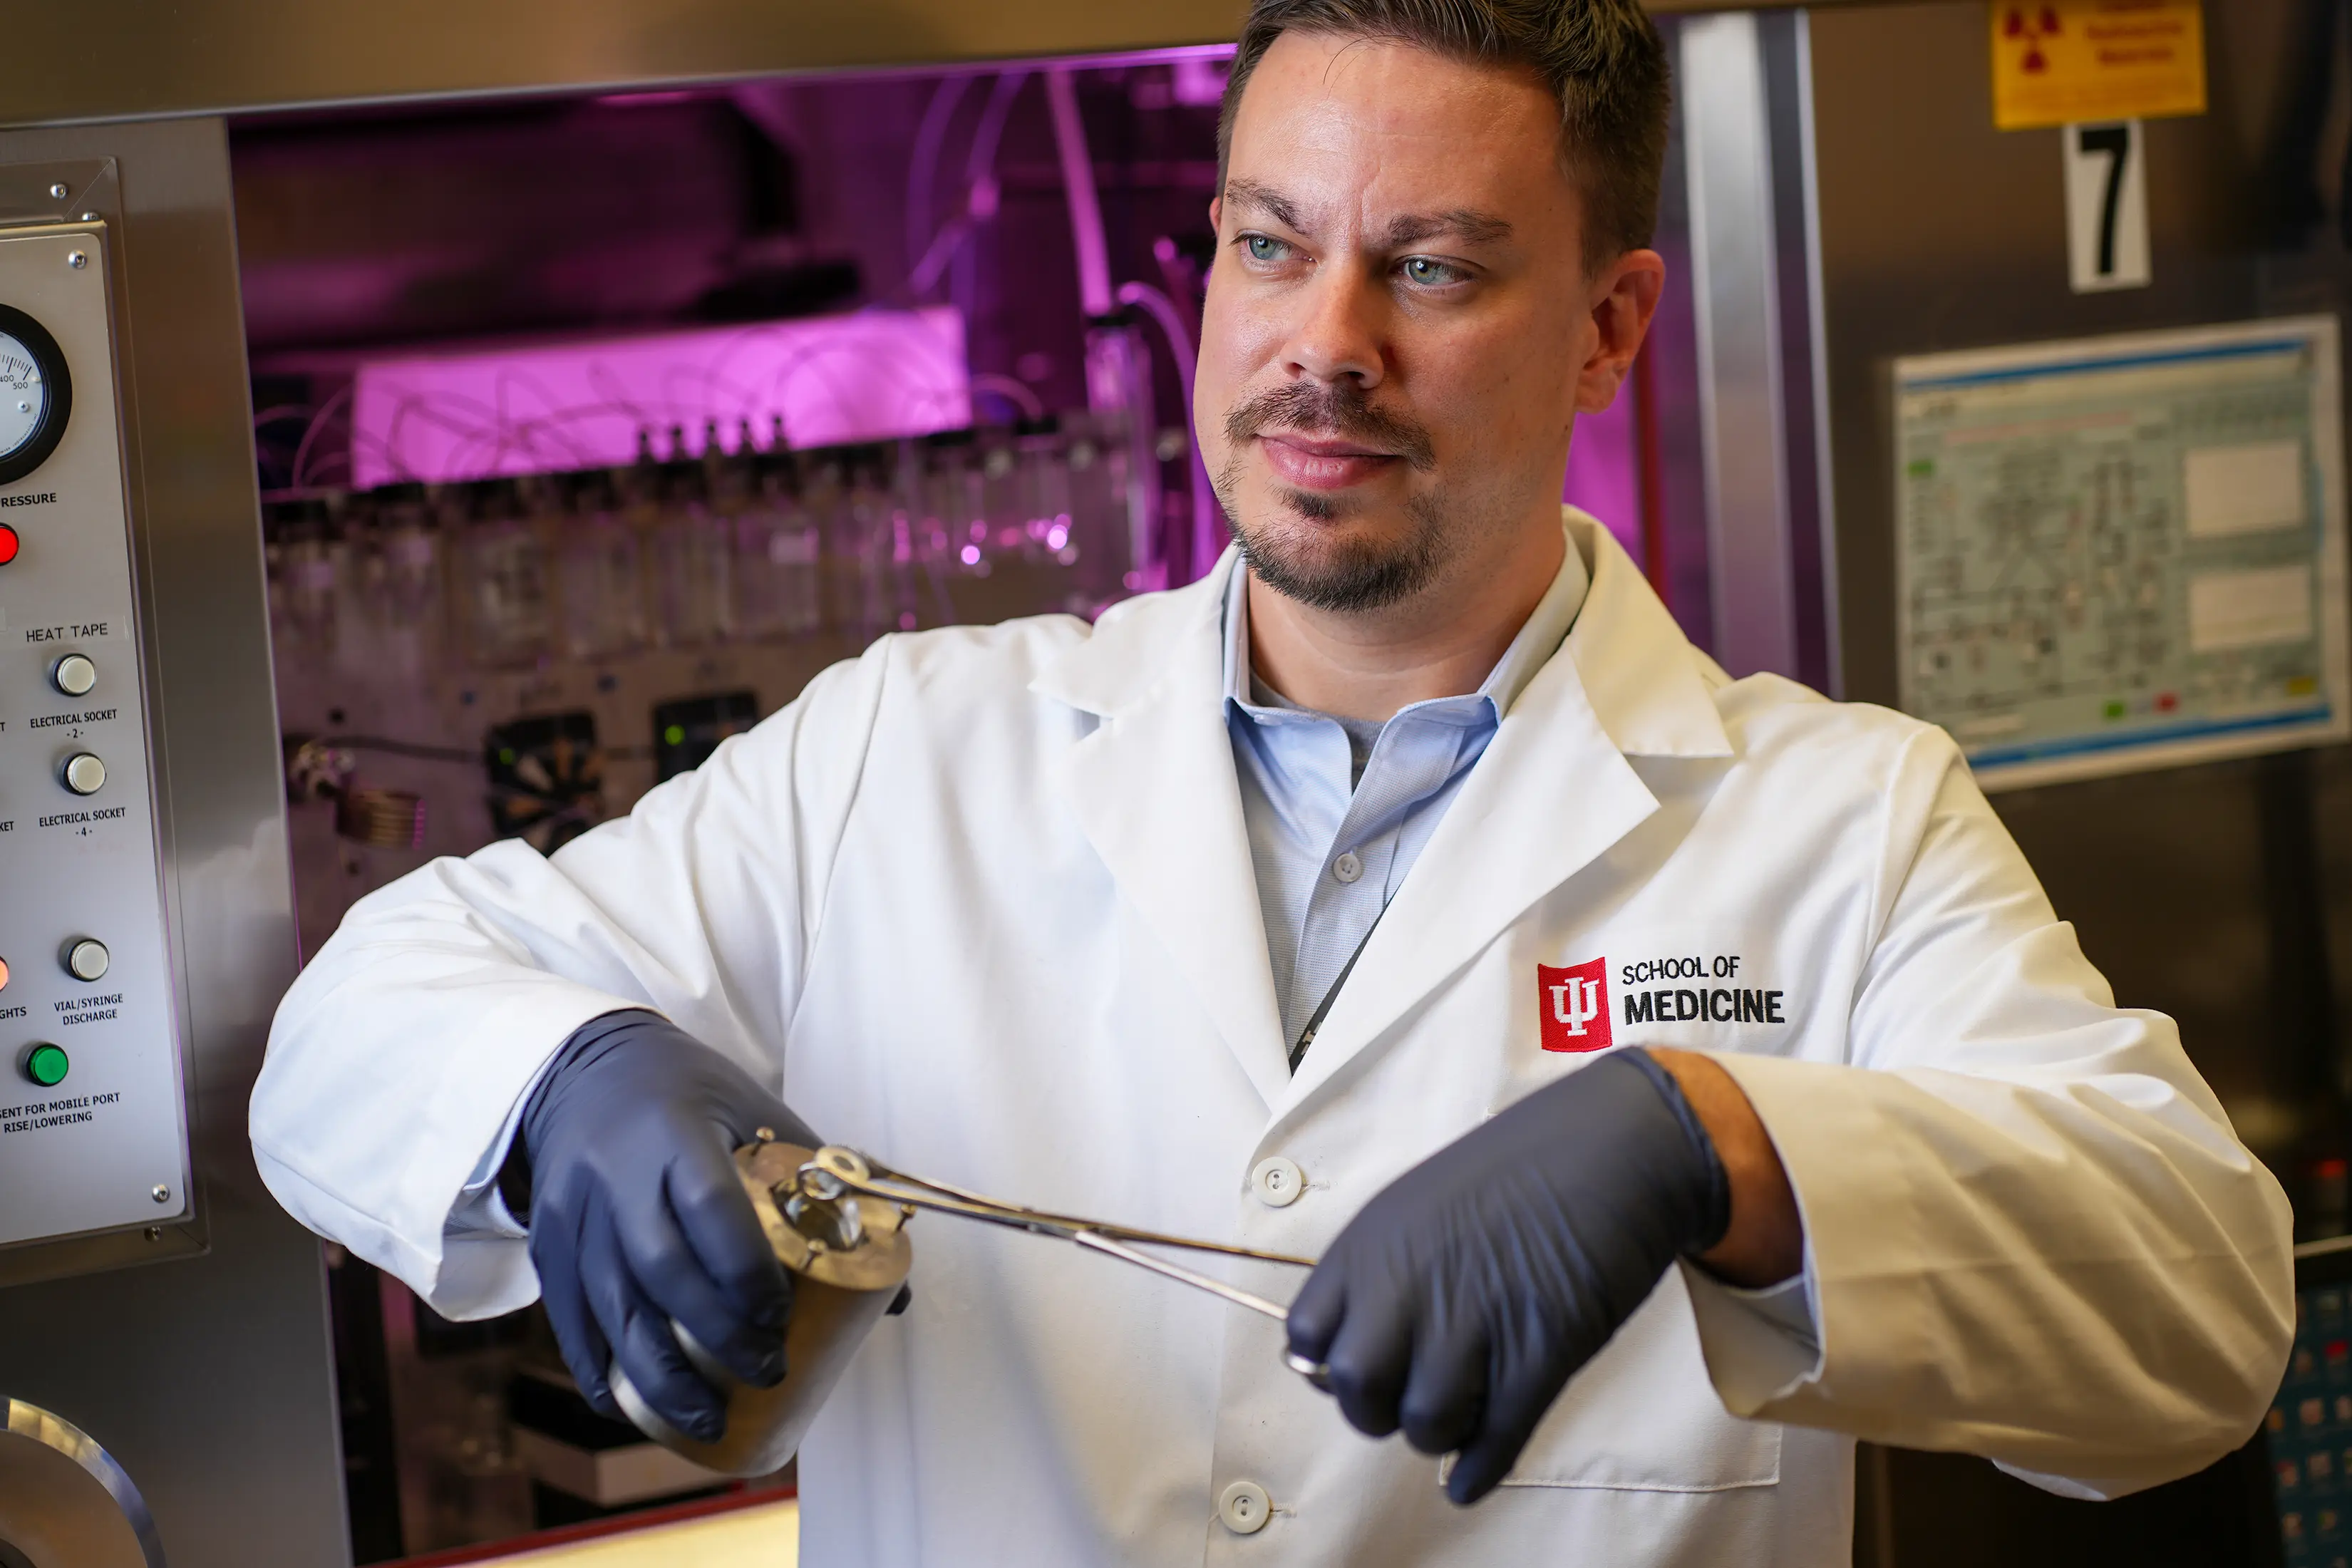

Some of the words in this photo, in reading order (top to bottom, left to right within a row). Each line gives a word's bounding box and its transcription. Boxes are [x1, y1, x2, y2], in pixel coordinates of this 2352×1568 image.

[2078, 122, 2130, 275] 7
[0, 492, 56, 507] RESSURE
[26, 627, 63, 642] HEAT
[70, 622, 108, 637] TAPE
[30, 713, 82, 728] ELECTRICAL
[84, 708, 117, 722] SOCKET
[39, 812, 91, 827] ELECTRICAL
[93, 807, 125, 820] SOCKET
[1622, 956, 1709, 985] SCHOOL
[1713, 956, 1740, 979] OF
[54, 993, 123, 1011] VIAL/SYRINGE
[1624, 989, 1785, 1025] MEDICINE
[63, 1009, 117, 1025] DISCHARGE
[25, 1104, 46, 1115] FOR
[49, 1097, 90, 1112] MOBILE
[93, 1092, 120, 1105] PORT
[4, 1111, 92, 1133] RISE/LOWERING
